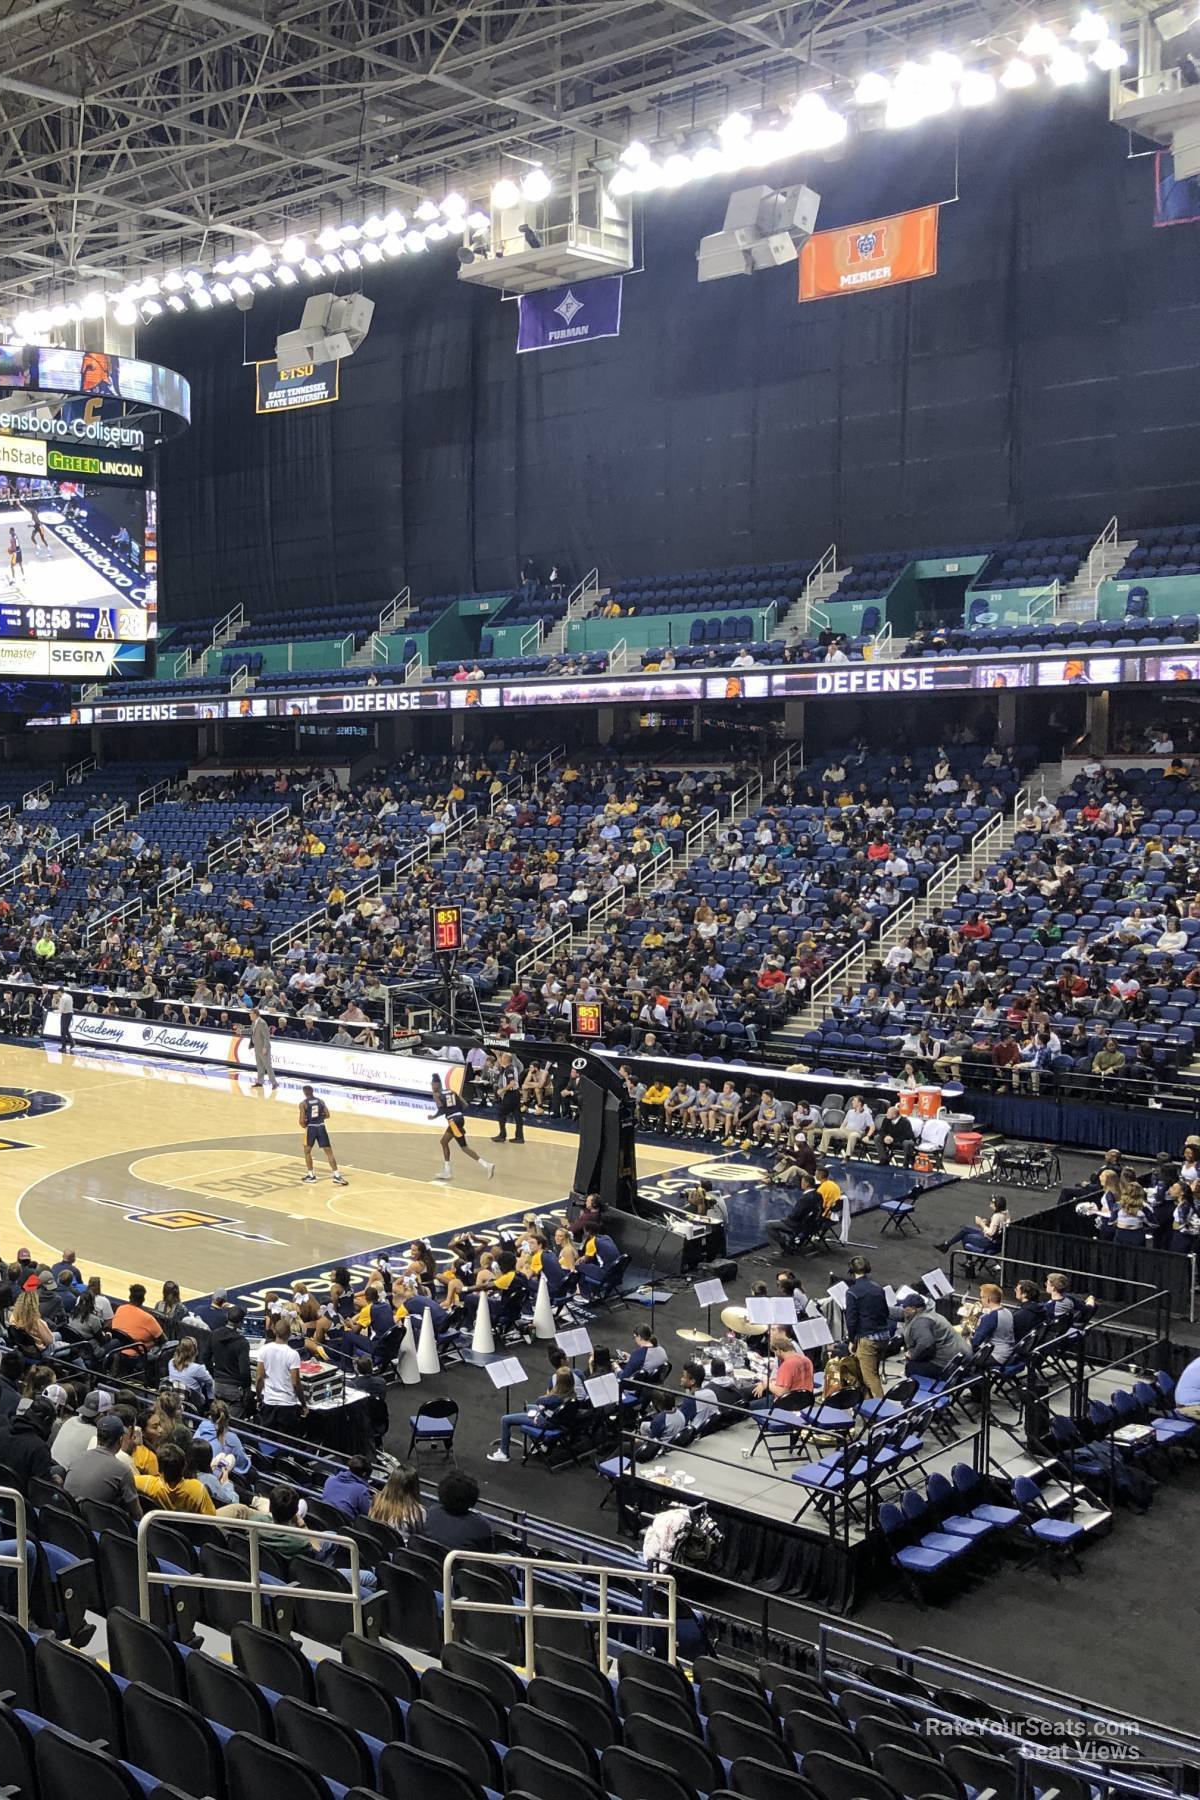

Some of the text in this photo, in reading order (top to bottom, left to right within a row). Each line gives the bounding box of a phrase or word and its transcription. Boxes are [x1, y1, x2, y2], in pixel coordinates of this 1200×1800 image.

[840, 266, 892, 287] MERCER
[565, 302, 574, 313] F
[548, 325, 589, 341] FURMAN
[280, 363, 314, 381] ETSU
[265, 390, 329, 409] STATE UNIVERSITY
[268, 382, 326, 400] EAST TENNESSEE
[72, 418, 145, 445] Coliseum
[99, 459, 143, 478] LINCOLN
[54, 524, 133, 587] Greensboro
[25, 607, 71, 630] 18:58
[52, 649, 105, 663] SEGRA
[816, 668, 935, 694] DEFENSE
[343, 692, 421, 711] DEFENSE
[116, 704, 177, 721] DEFENSE
[437, 924, 456, 946] 30
[579, 1006, 599, 1018] 18:57
[75, 1018, 125, 1042] Academy
[580, 1018, 597, 1032] 30
[154, 1029, 210, 1054] Academy
[311, 1105, 319, 1118] 2
